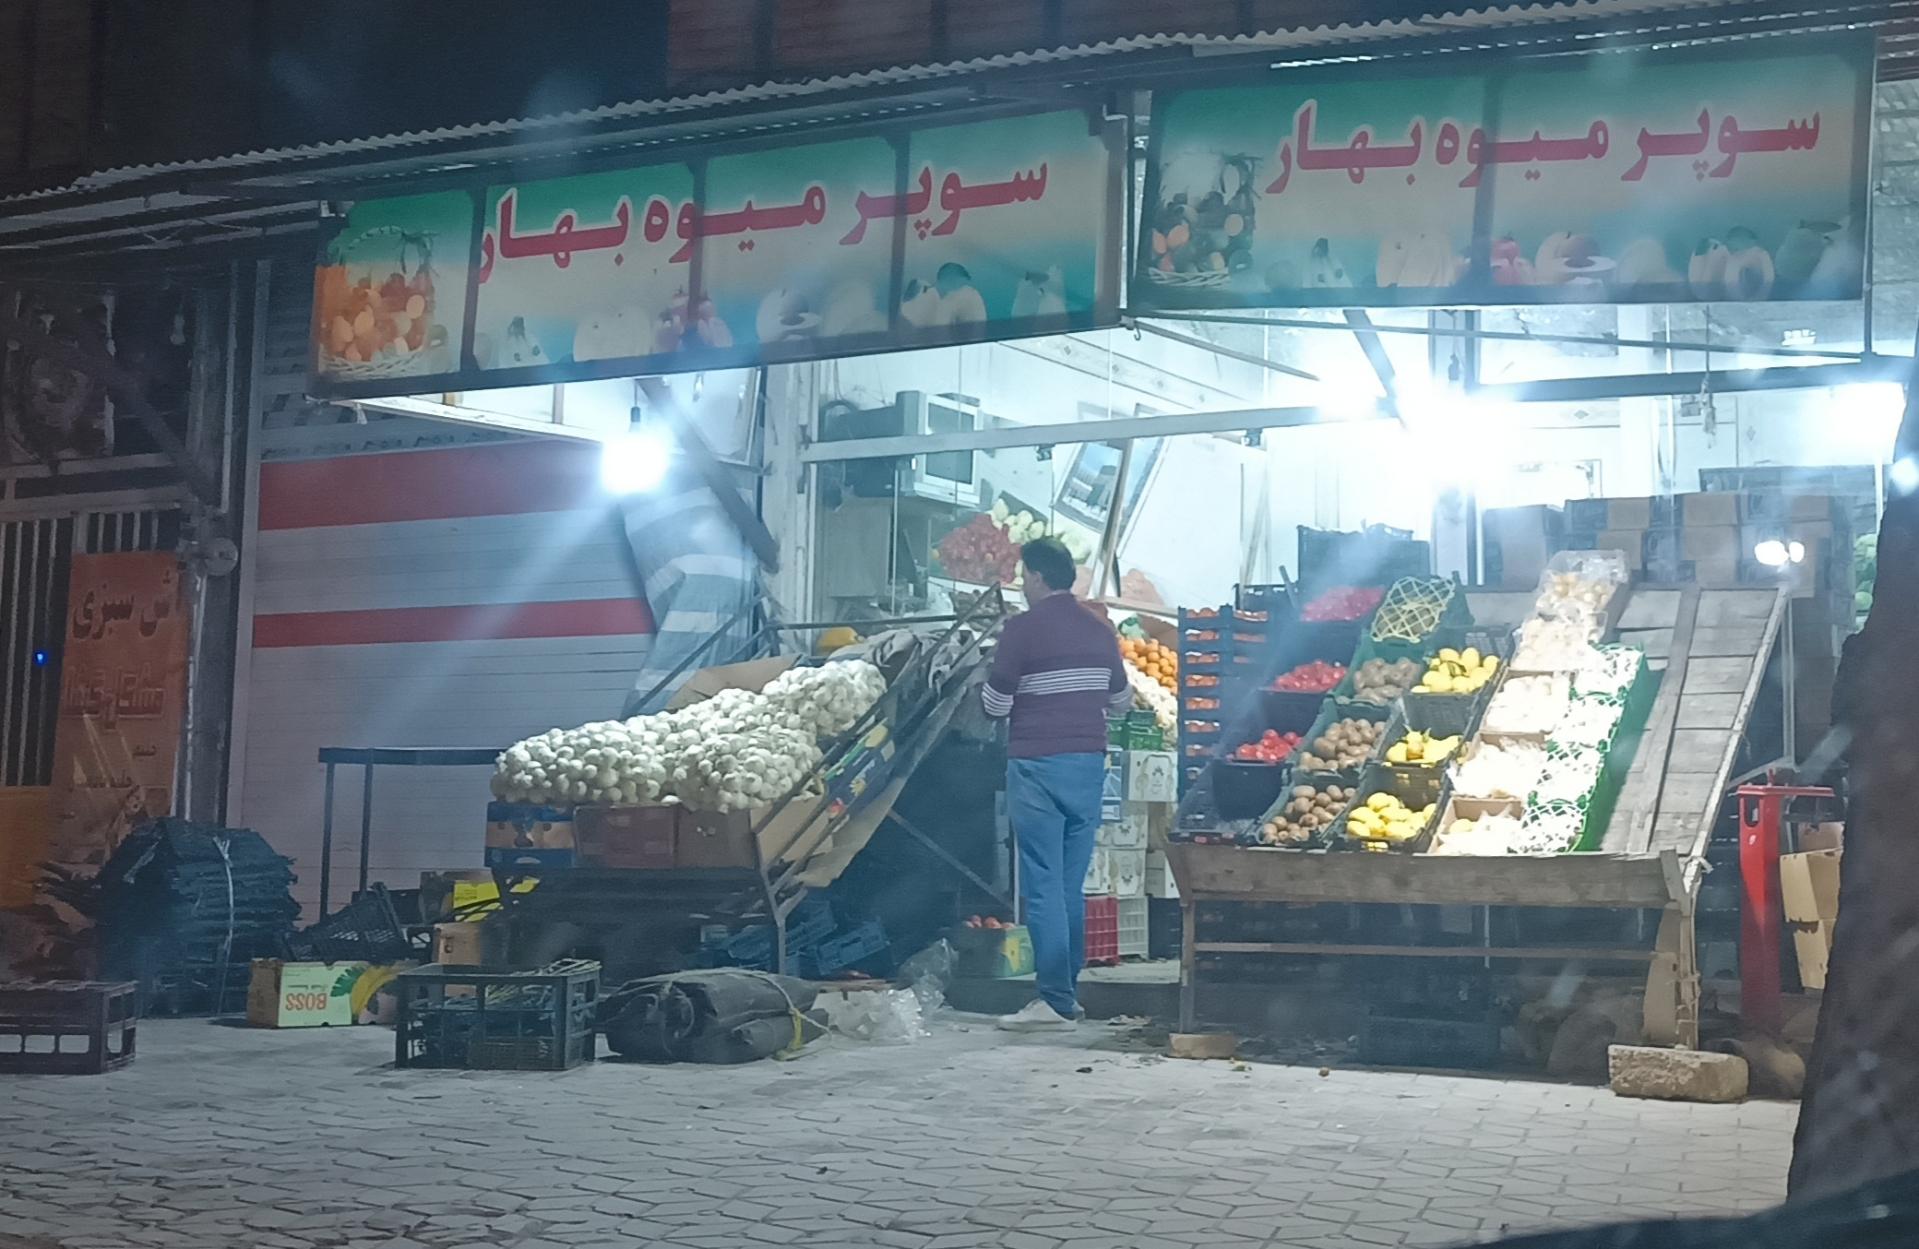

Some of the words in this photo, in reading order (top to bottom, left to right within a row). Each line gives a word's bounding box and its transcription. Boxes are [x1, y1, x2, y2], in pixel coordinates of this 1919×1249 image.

[1265, 105, 1422, 194] بهار
[1436, 119, 1609, 189] میوه
[1621, 107, 1820, 182] سوپر
[477, 194, 630, 285] بهار
[644, 185, 826, 264] میوه
[838, 162, 1048, 245] سوپر
[286, 992, 327, 1011] BOSS
